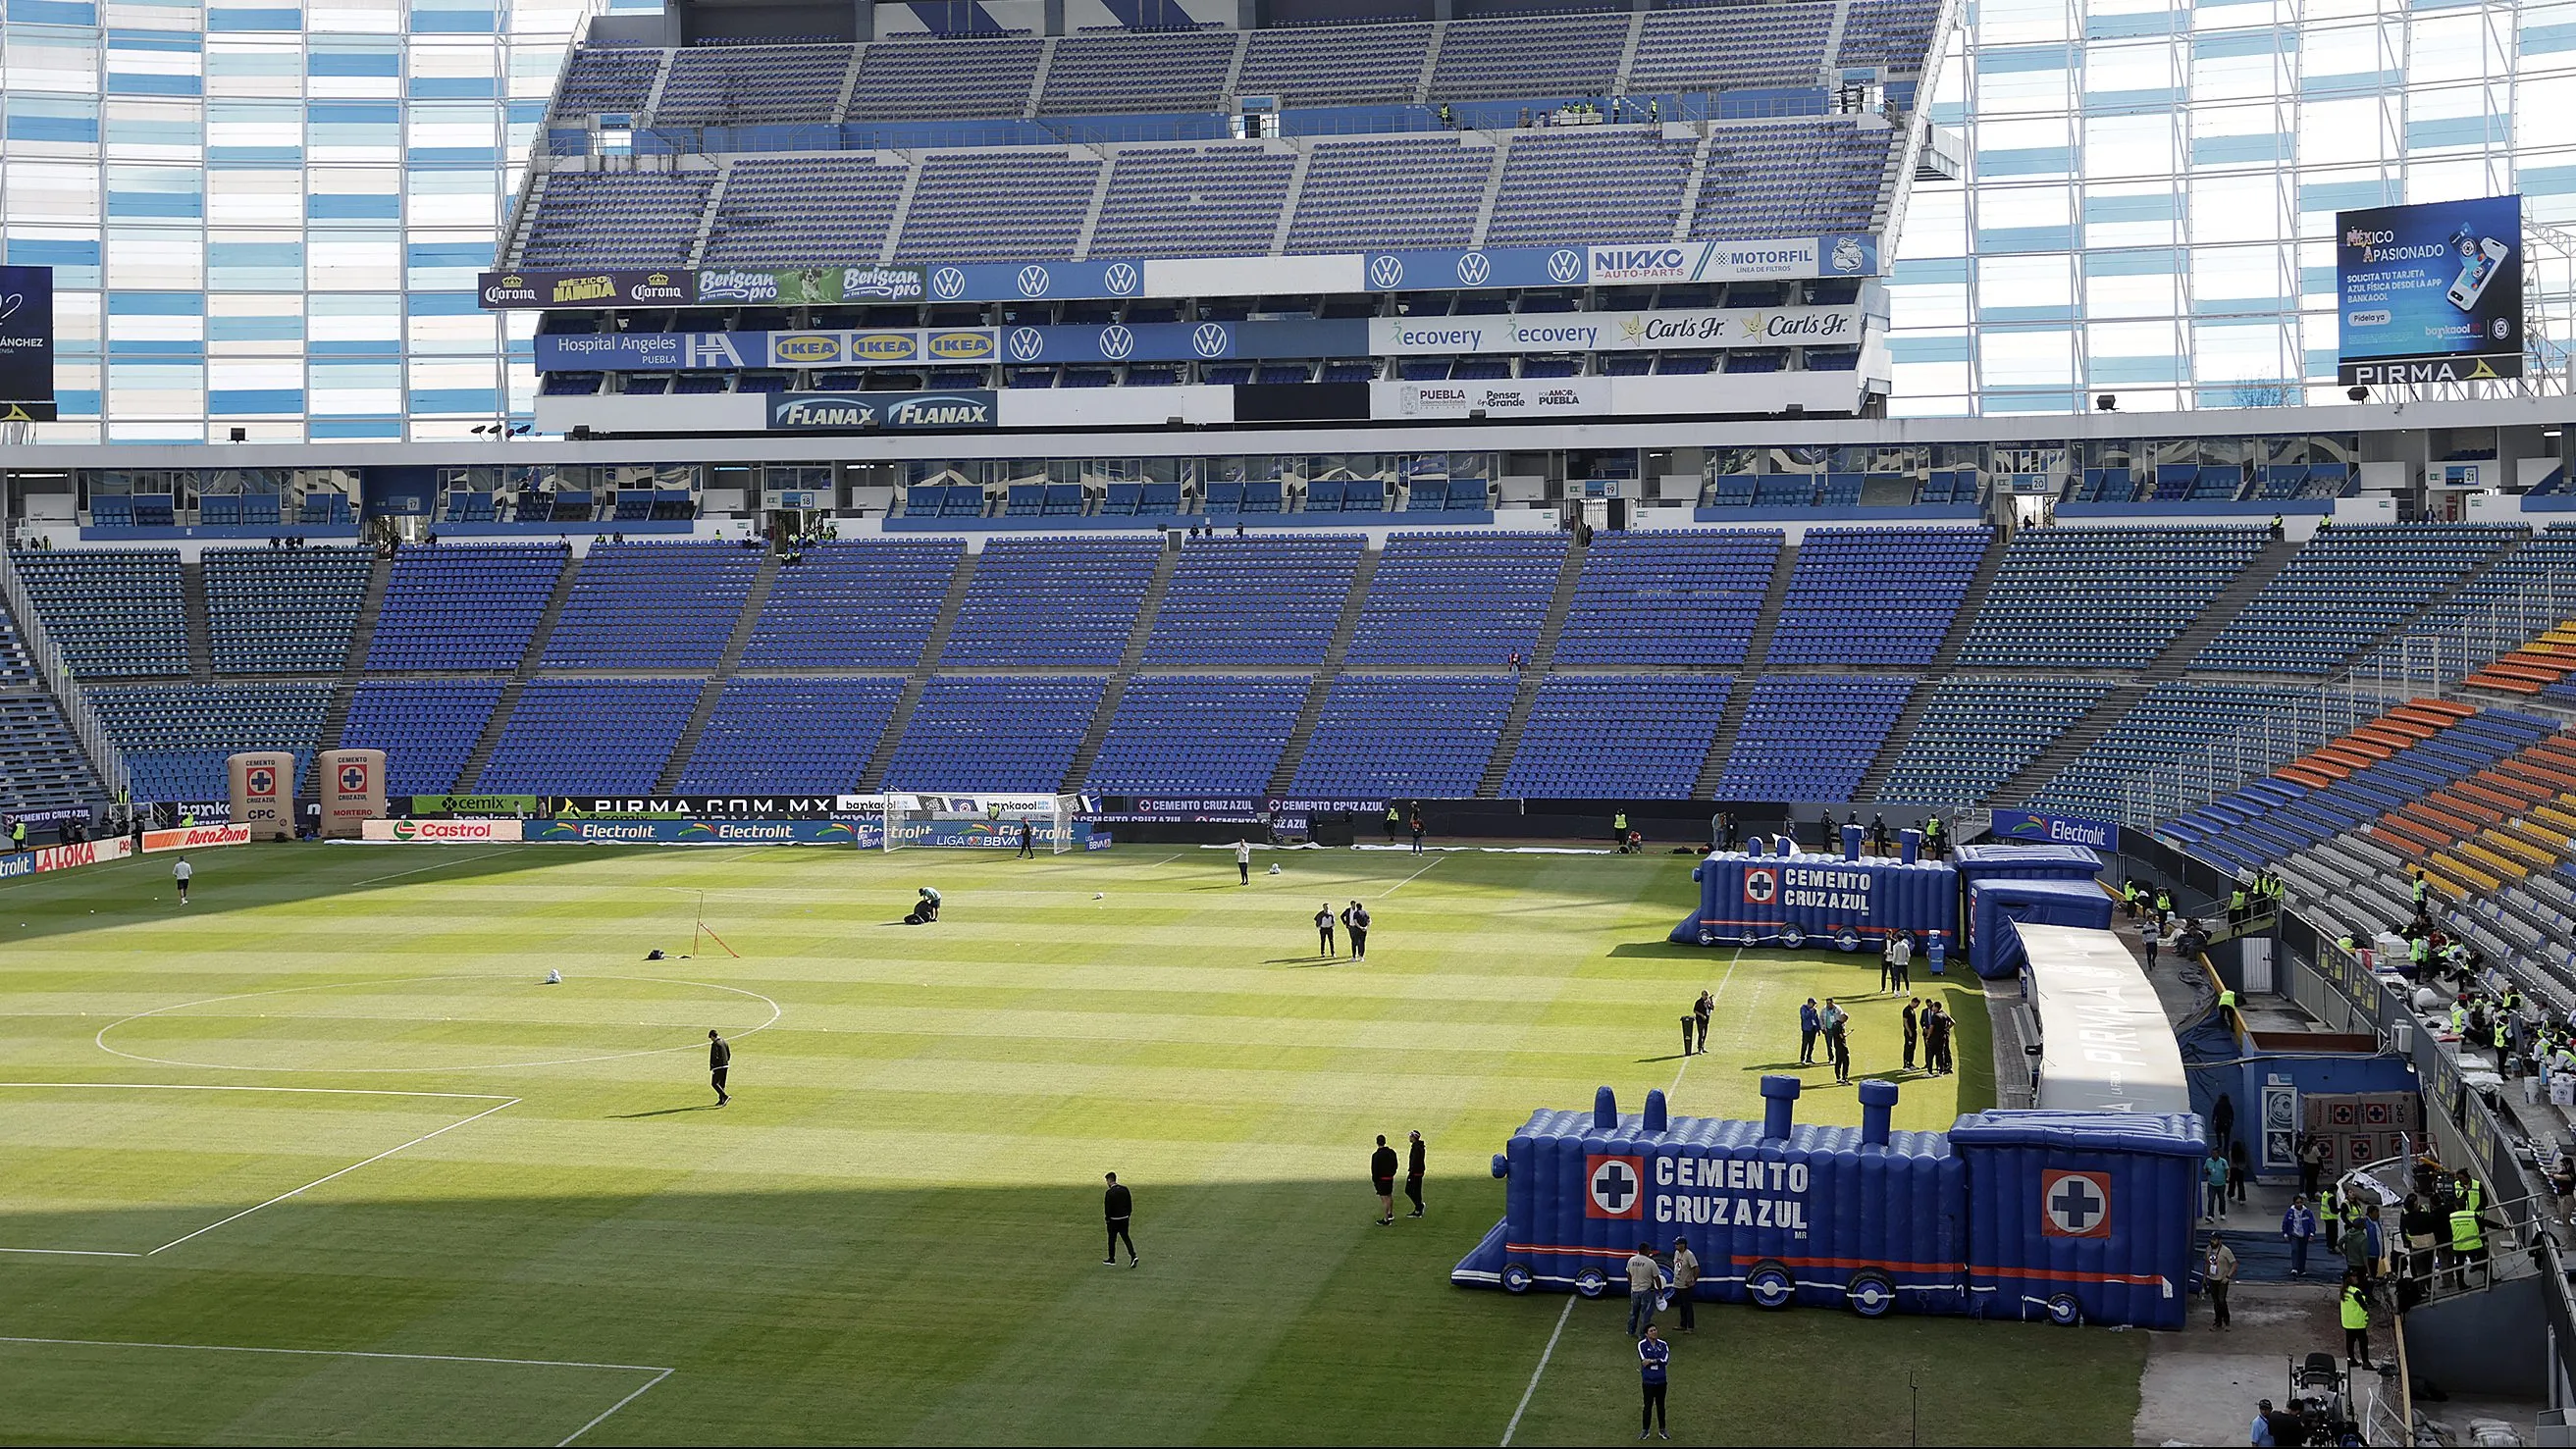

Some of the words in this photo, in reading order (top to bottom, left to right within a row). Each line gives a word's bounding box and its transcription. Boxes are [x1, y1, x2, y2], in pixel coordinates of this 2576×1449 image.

[1596, 249, 1684, 271] NIKKO
[1731, 249, 1814, 265] MOTORFIL
[2363, 244, 2444, 263] APASIONADO
[699, 269, 774, 290] Beriscan
[843, 267, 919, 289] Beriscan
[1603, 269, 1685, 279] AUTO-PARTS
[2347, 273, 2380, 283] SOLICITA
[2392, 270, 2425, 279] TARJETA
[485, 286, 535, 304] Corona
[631, 284, 682, 304] Corona
[749, 285, 777, 302] pro
[892, 285, 920, 299] pro
[2347, 285, 2366, 293] AZUL
[2392, 281, 2415, 289] DESDE
[1645, 318, 1697, 339] Carl's
[1699, 317, 1724, 338] Jr.
[1767, 314, 1817, 336] Carl's
[1821, 313, 1847, 335] Jr.
[0, 336, 43, 347] ÁNCHEZ
[558, 336, 615, 354] Hospital
[621, 336, 676, 353] Angeles
[781, 341, 835, 354] IKEA
[859, 340, 912, 353] IKEA
[934, 339, 989, 351] IKEA
[2356, 363, 2456, 386] PIRMA
[1420, 389, 1465, 399] PUEBLA
[1487, 390, 1520, 399] Pensar
[1539, 396, 1580, 405] PUEBLA
[1489, 398, 1526, 407] Grande
[787, 404, 875, 425] FLANAX
[898, 404, 987, 424] FLANAX
[459, 798, 505, 809] cemix
[1152, 800, 1200, 810] CEMENTO
[1203, 801, 1228, 810] CRUZ
[1229, 801, 1254, 810] AZUL
[1282, 801, 1331, 811] CEMENTO
[1360, 801, 1385, 811] AZUL
[52, 809, 72, 820] CRUZ
[248, 809, 275, 819] CPC
[185, 828, 248, 845] AutoZone
[421, 823, 491, 838] Castrol
[582, 824, 656, 838] Electrolit
[718, 824, 793, 839] Electrolit
[2051, 820, 2106, 846] Electrolit
[936, 836, 965, 846] LIGA
[983, 836, 1018, 846] BBVA
[56, 841, 96, 870] LOKA
[0, 855, 29, 877] trolit
[1785, 868, 1870, 891] CEMENTO
[1785, 890, 1826, 907] CRUZ
[1828, 893, 1869, 910] AZUL
[1656, 1157, 1809, 1193] CEMENTO
[1656, 1194, 1728, 1225] CRUZ
[1733, 1198, 1808, 1229] AZUL
